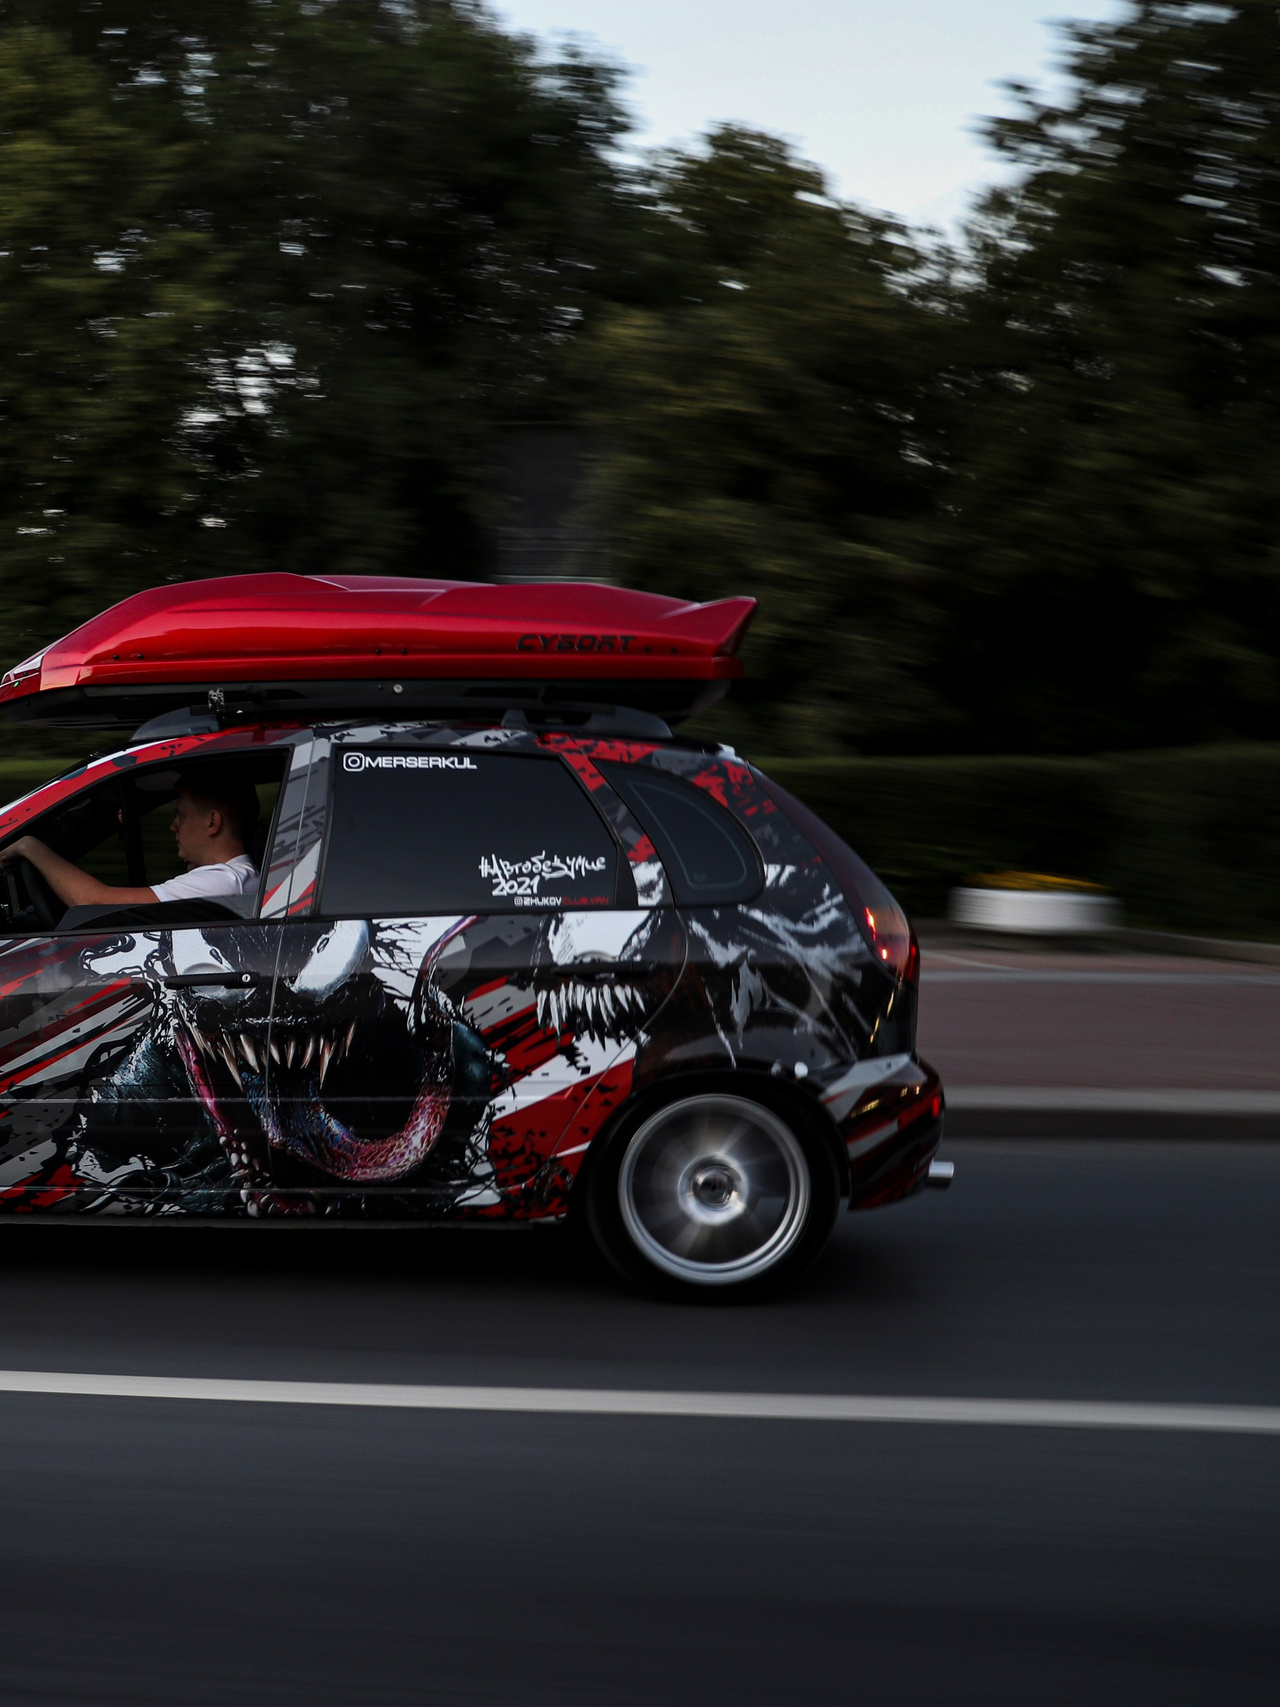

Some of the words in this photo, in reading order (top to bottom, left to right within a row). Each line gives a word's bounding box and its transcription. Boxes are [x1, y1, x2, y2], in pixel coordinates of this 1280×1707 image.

[517, 634, 636, 651] CYBORT
[365, 756, 477, 769] MERSERKUL
[492, 875, 540, 896] 2021
